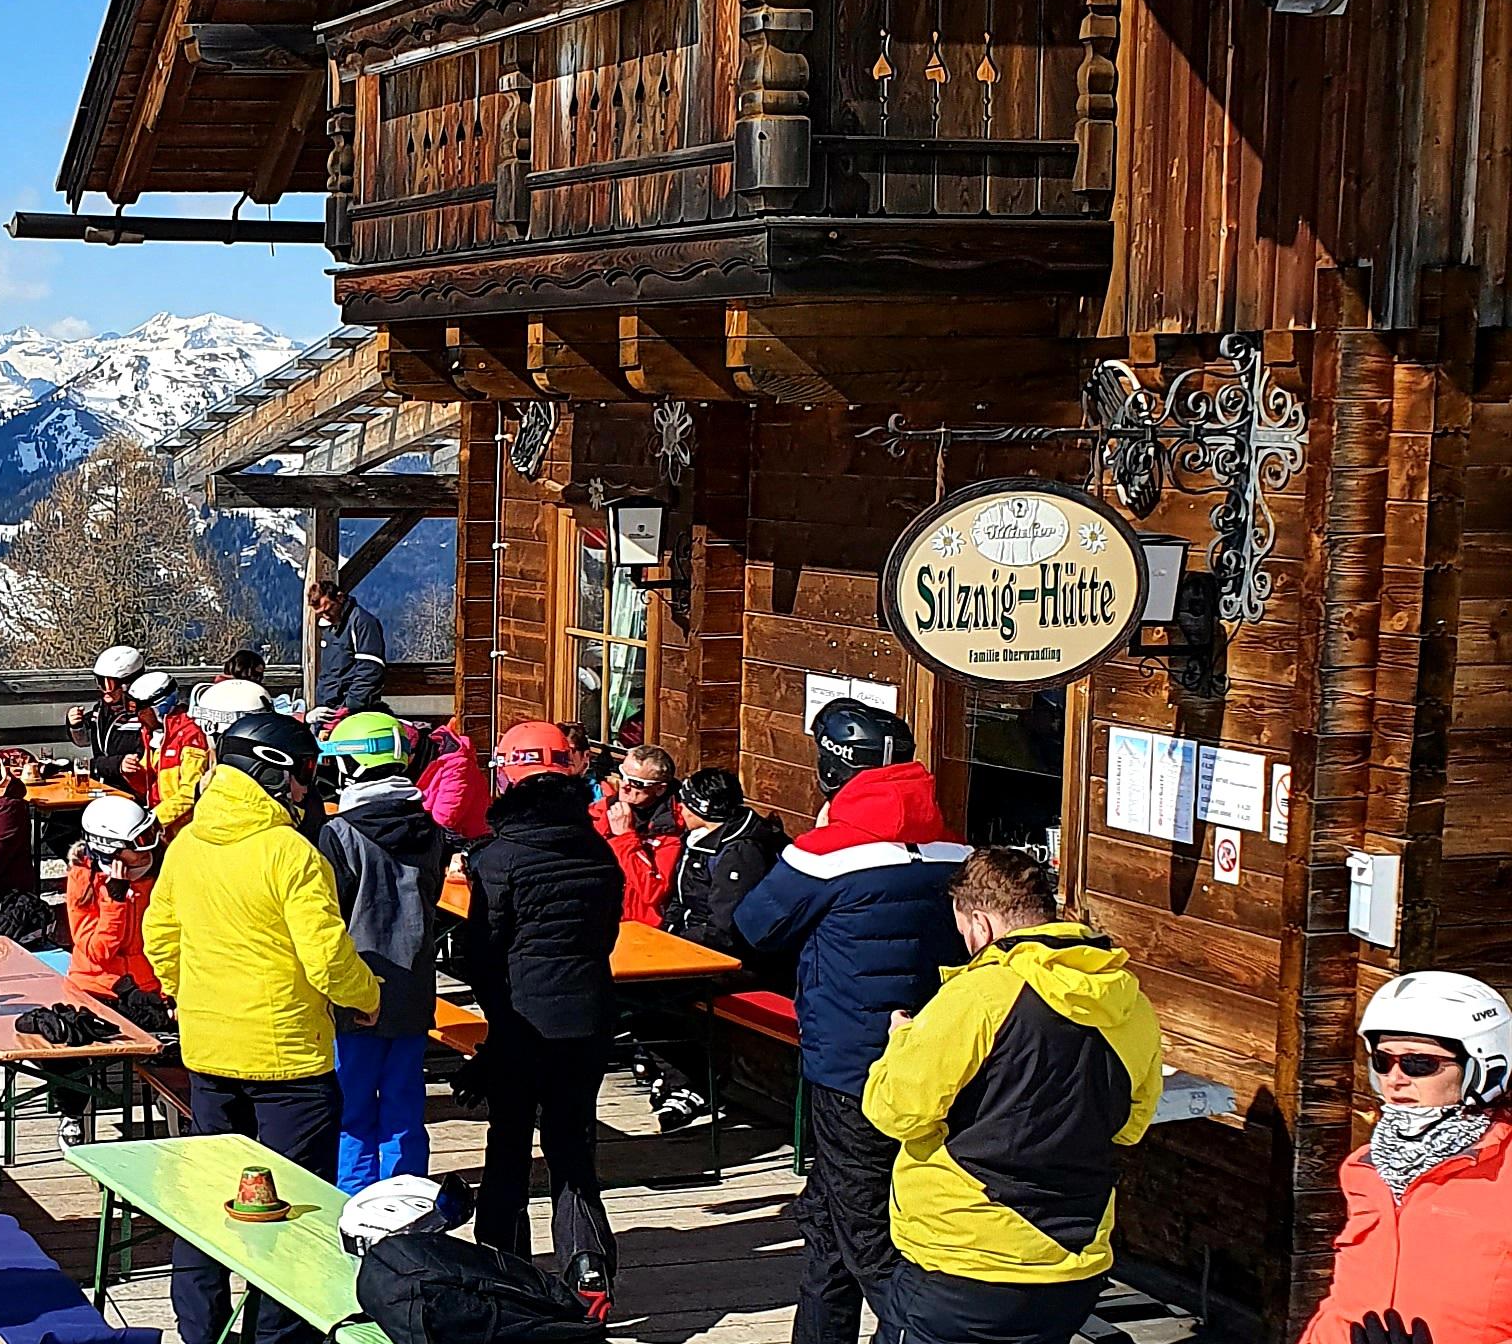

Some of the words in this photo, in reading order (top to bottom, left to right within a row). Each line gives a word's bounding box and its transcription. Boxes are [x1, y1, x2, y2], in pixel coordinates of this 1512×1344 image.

[915, 562, 1117, 642] Silznig-Hütte
[968, 648, 1000, 663] Familie
[1471, 1007, 1499, 1022] uvex
